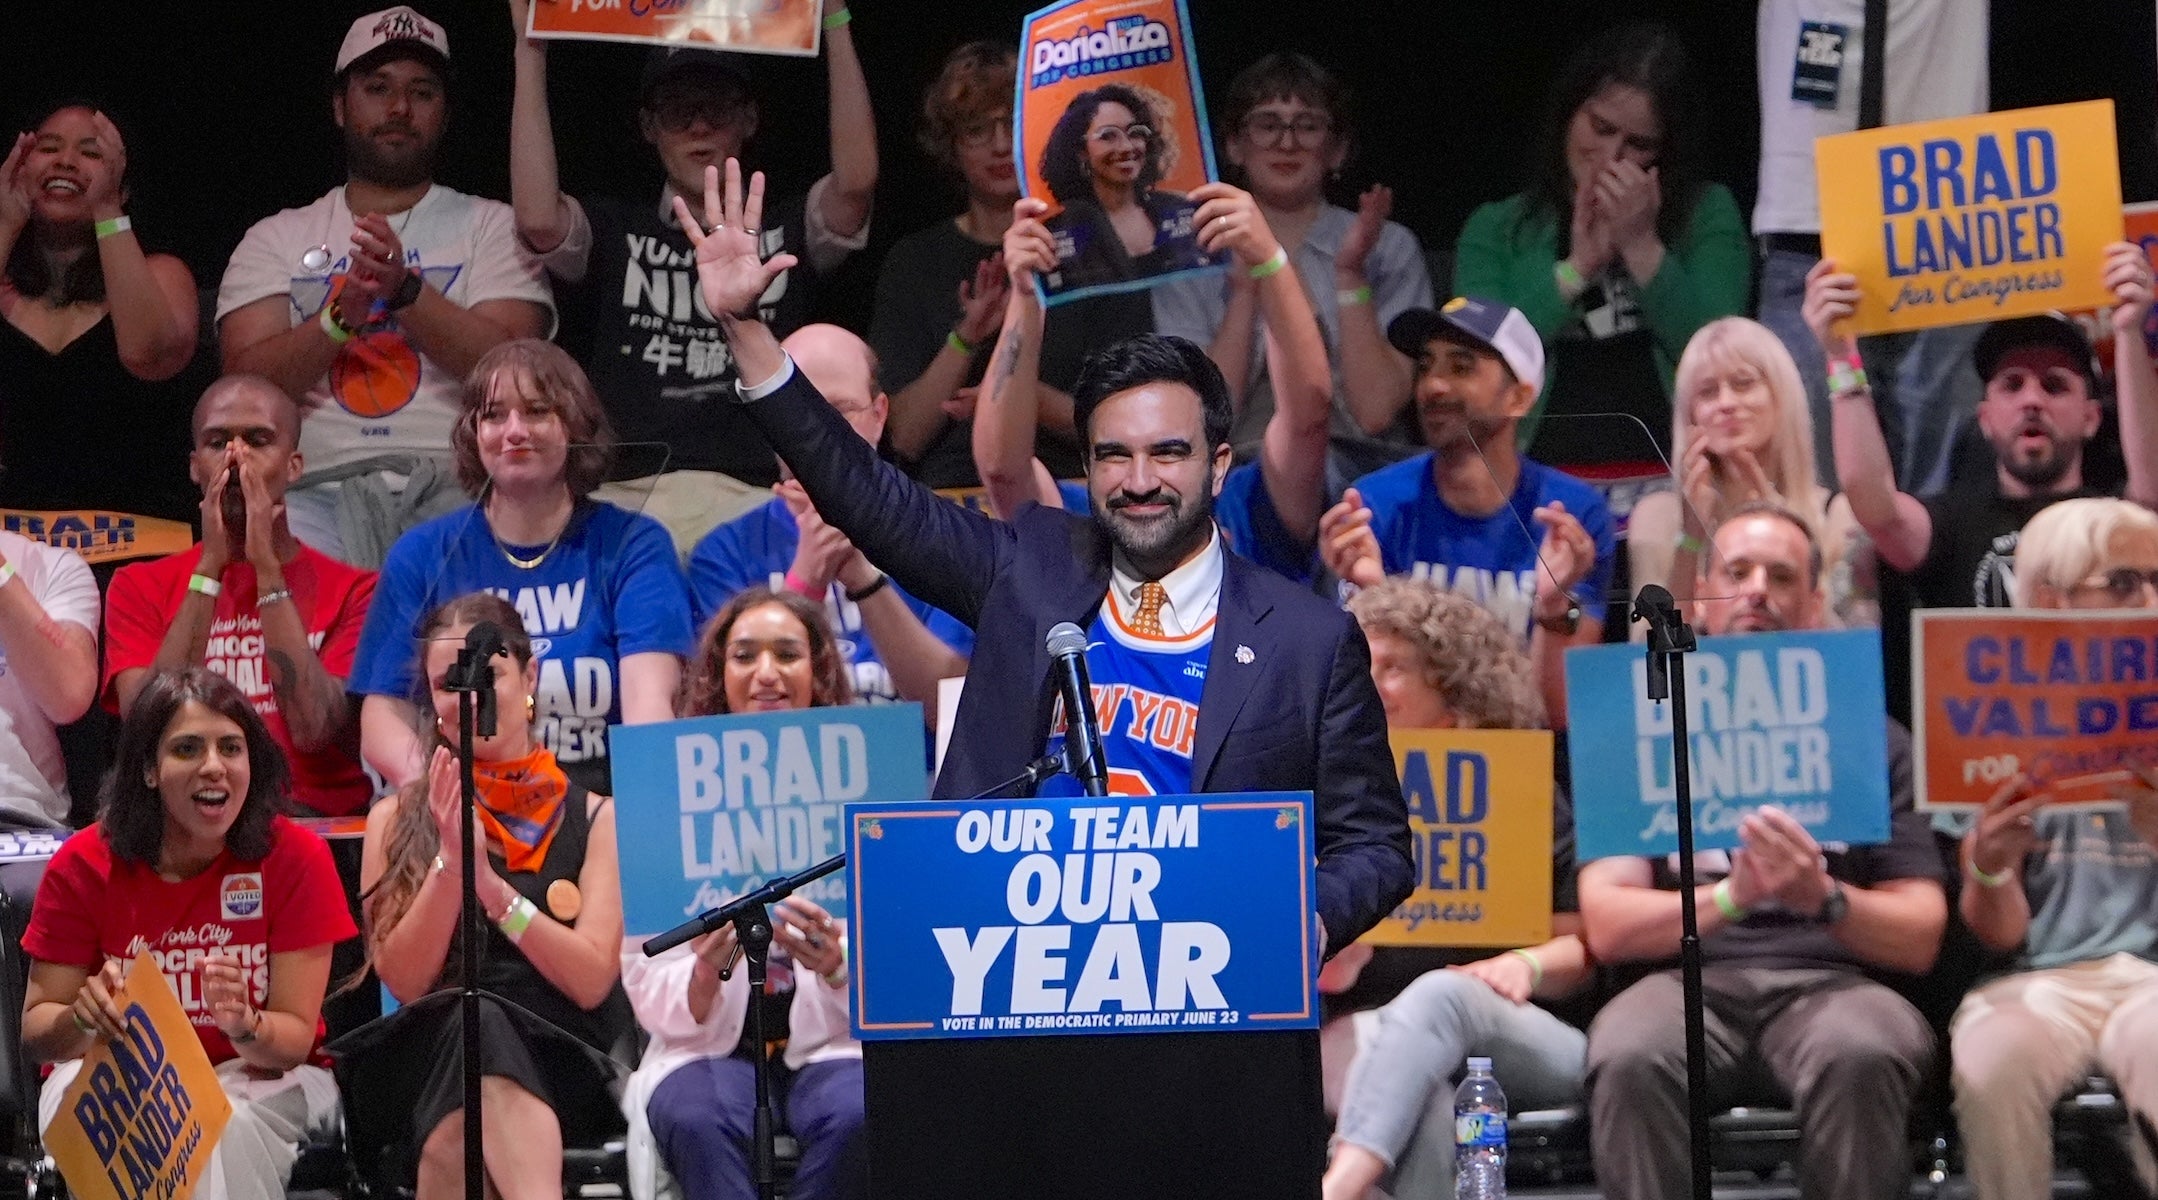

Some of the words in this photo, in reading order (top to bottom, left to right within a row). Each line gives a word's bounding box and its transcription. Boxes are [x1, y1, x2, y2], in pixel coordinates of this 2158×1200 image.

[1033, 20, 1170, 76] Darializa
[1067, 47, 1172, 79] CONGRESS
[1879, 128, 2059, 216] BRAD
[1883, 202, 2065, 278] LANDER
[1888, 280, 1935, 313] for
[1943, 269, 2063, 306] Congress
[629, 313, 664, 329] FOR
[484, 577, 586, 635] AW
[537, 656, 613, 719] AD
[1964, 635, 2158, 686] CLAIR
[1126, 684, 1199, 761] YOR
[1943, 695, 2158, 737] VALDE
[676, 723, 869, 814] BRAD
[1399, 748, 1489, 825] AD
[1962, 754, 2019, 785] FOR
[679, 803, 845, 881] LANDE
[955, 808, 1055, 854] OUR
[1068, 804, 1199, 851] TEAM
[230, 891, 261, 902] VOTED
[1006, 852, 1161, 925] OUR
[198, 922, 233, 947] City
[932, 921, 1232, 1016] YEAR
[942, 1016, 977, 1031] VOTE
[979, 1016, 997, 1030] IN
[998, 1016, 1022, 1030] THE
[1025, 1014, 1113, 1029] DEMOCRATIC
[1114, 1012, 1181, 1027] PRIMARY
[1182, 1011, 1217, 1025] JUNE
[1219, 1010, 1239, 1025] 23
[74, 1001, 165, 1169] BRAD
